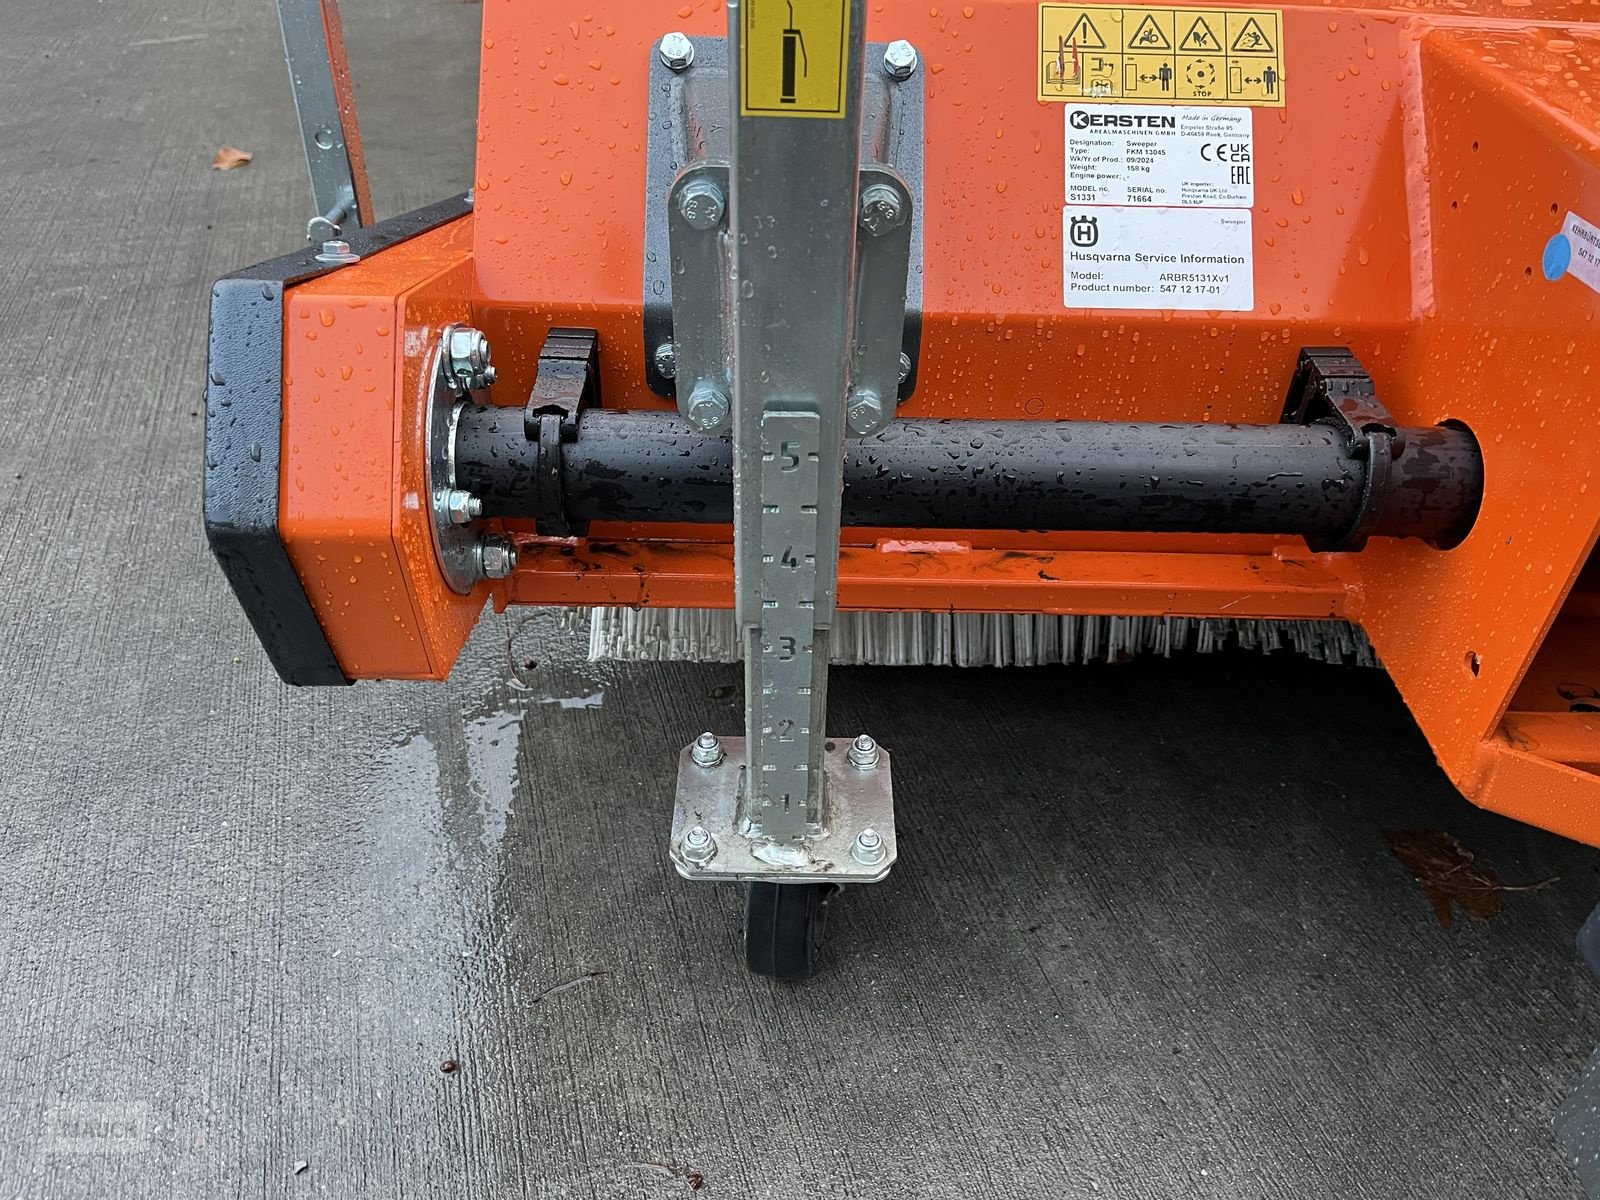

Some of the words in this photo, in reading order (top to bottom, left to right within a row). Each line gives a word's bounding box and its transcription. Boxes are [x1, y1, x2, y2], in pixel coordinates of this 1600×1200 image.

[1070, 111, 1176, 129] KERSTEN
[1210, 115, 1242, 123] Germany
[1069, 139, 1114, 147] Designation:
[1126, 140, 1157, 148] Sweeper
[1141, 165, 1150, 173] kg
[1070, 193, 1096, 201] S1331
[1070, 251, 1131, 263] Husqvarna
[1135, 252, 1177, 262] Service
[1180, 253, 1245, 264] Information
[1070, 271, 1104, 280] Model:
[1159, 273, 1229, 282] ARBR5131Xv1
[1070, 282, 1110, 292] Product
[1113, 284, 1155, 292] number:
[1160, 284, 1177, 293] 547
[1180, 285, 1192, 293] 12
[1195, 285, 1220, 294] 17-01
[780, 441, 801, 473] 5
[780, 545, 801, 572] 4
[778, 636, 797, 661] 3
[778, 719, 795, 742] 2
[780, 793, 790, 814] 1
